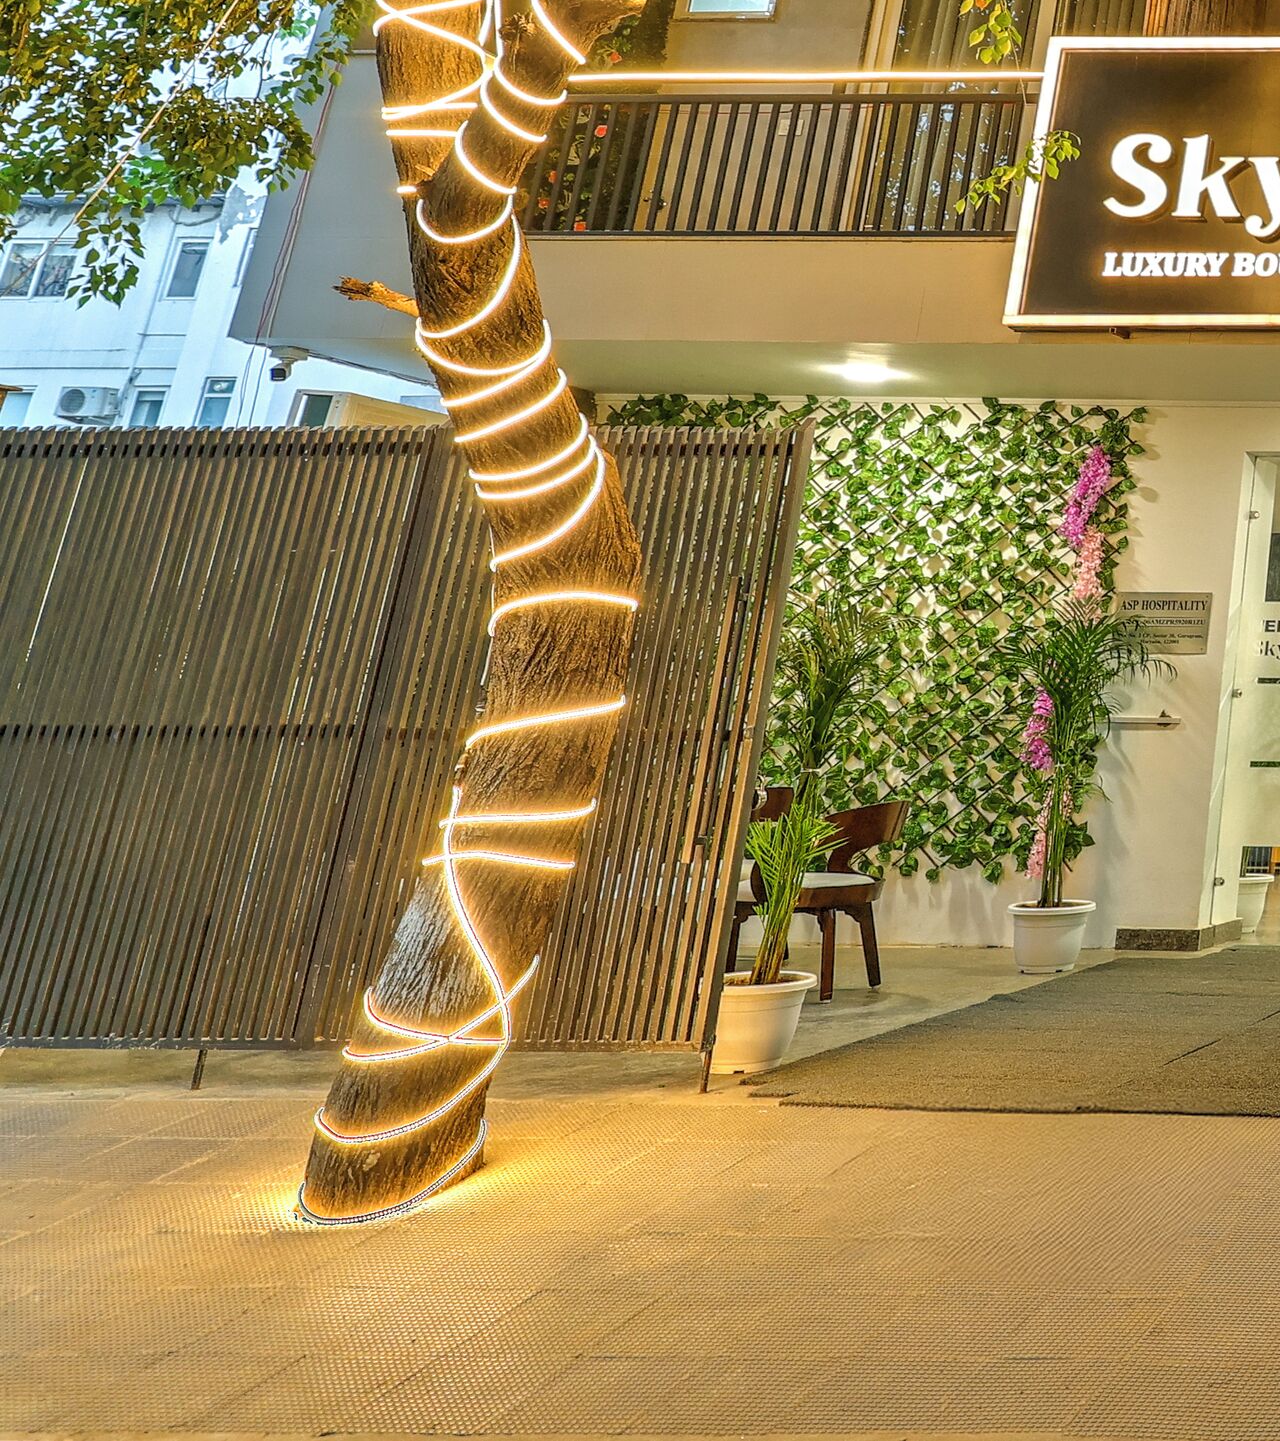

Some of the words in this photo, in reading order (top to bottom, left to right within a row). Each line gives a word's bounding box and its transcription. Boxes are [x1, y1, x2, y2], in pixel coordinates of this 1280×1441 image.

[1101, 252, 1229, 277] LUXURY
[1121, 600, 1140, 611] ASP
[1141, 600, 1208, 611] HOSPITALITY
